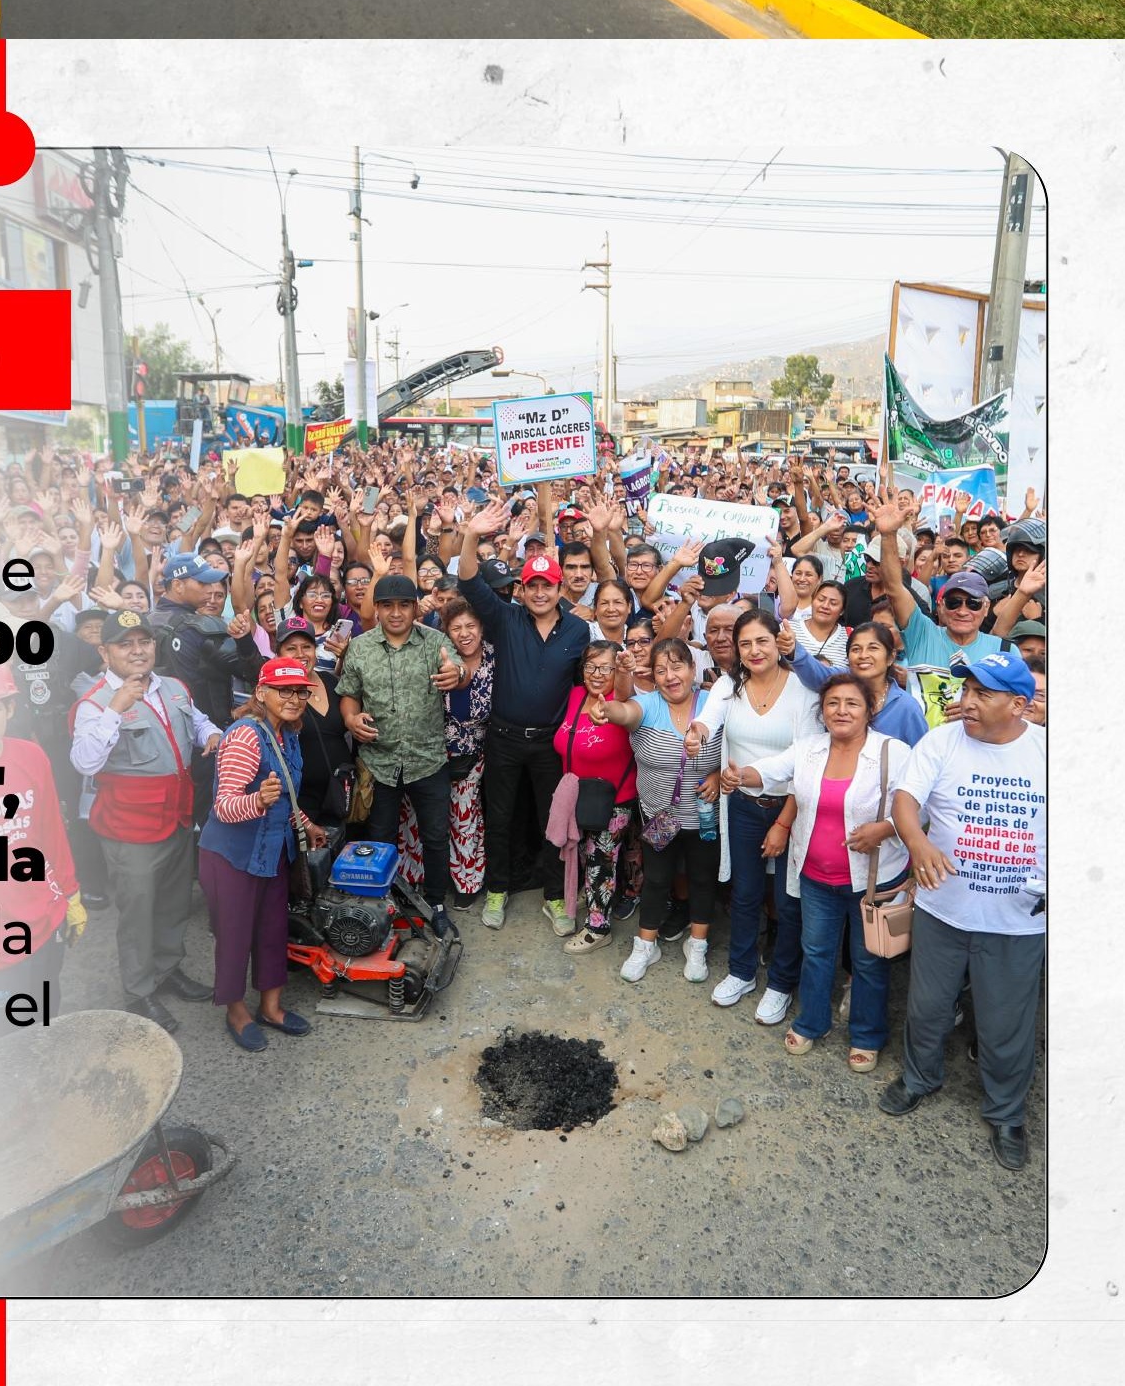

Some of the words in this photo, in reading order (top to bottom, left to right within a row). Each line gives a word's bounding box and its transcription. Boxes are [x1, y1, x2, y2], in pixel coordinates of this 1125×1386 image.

[501, 426, 547, 441] MARISCAL
[549, 421, 590, 435] CÁCERES
[508, 435, 584, 459] ¡PRESENTE!
[976, 423, 1008, 464] OLVIDO
[526, 457, 571, 470] LURIGANCHO
[972, 774, 1031, 788] Proyecto
[957, 786, 1045, 804] Construcción
[964, 800, 980, 810] de
[985, 802, 1027, 815] pistas
[1031, 808, 1038, 818] y
[957, 814, 1009, 827] veredas
[1013, 819, 1029, 829] de
[964, 824, 1034, 841] Ampliación
[957, 836, 1000, 850] cuidad
[1004, 841, 1020, 853] de
[1023, 843, 1036, 854] los
[954, 849, 1037, 865] constructores
[959, 859, 966, 867] Y
[972, 862, 1031, 874] agrupación
[995, 875, 1027, 884] unidos
[969, 882, 1020, 895] desarrollo
